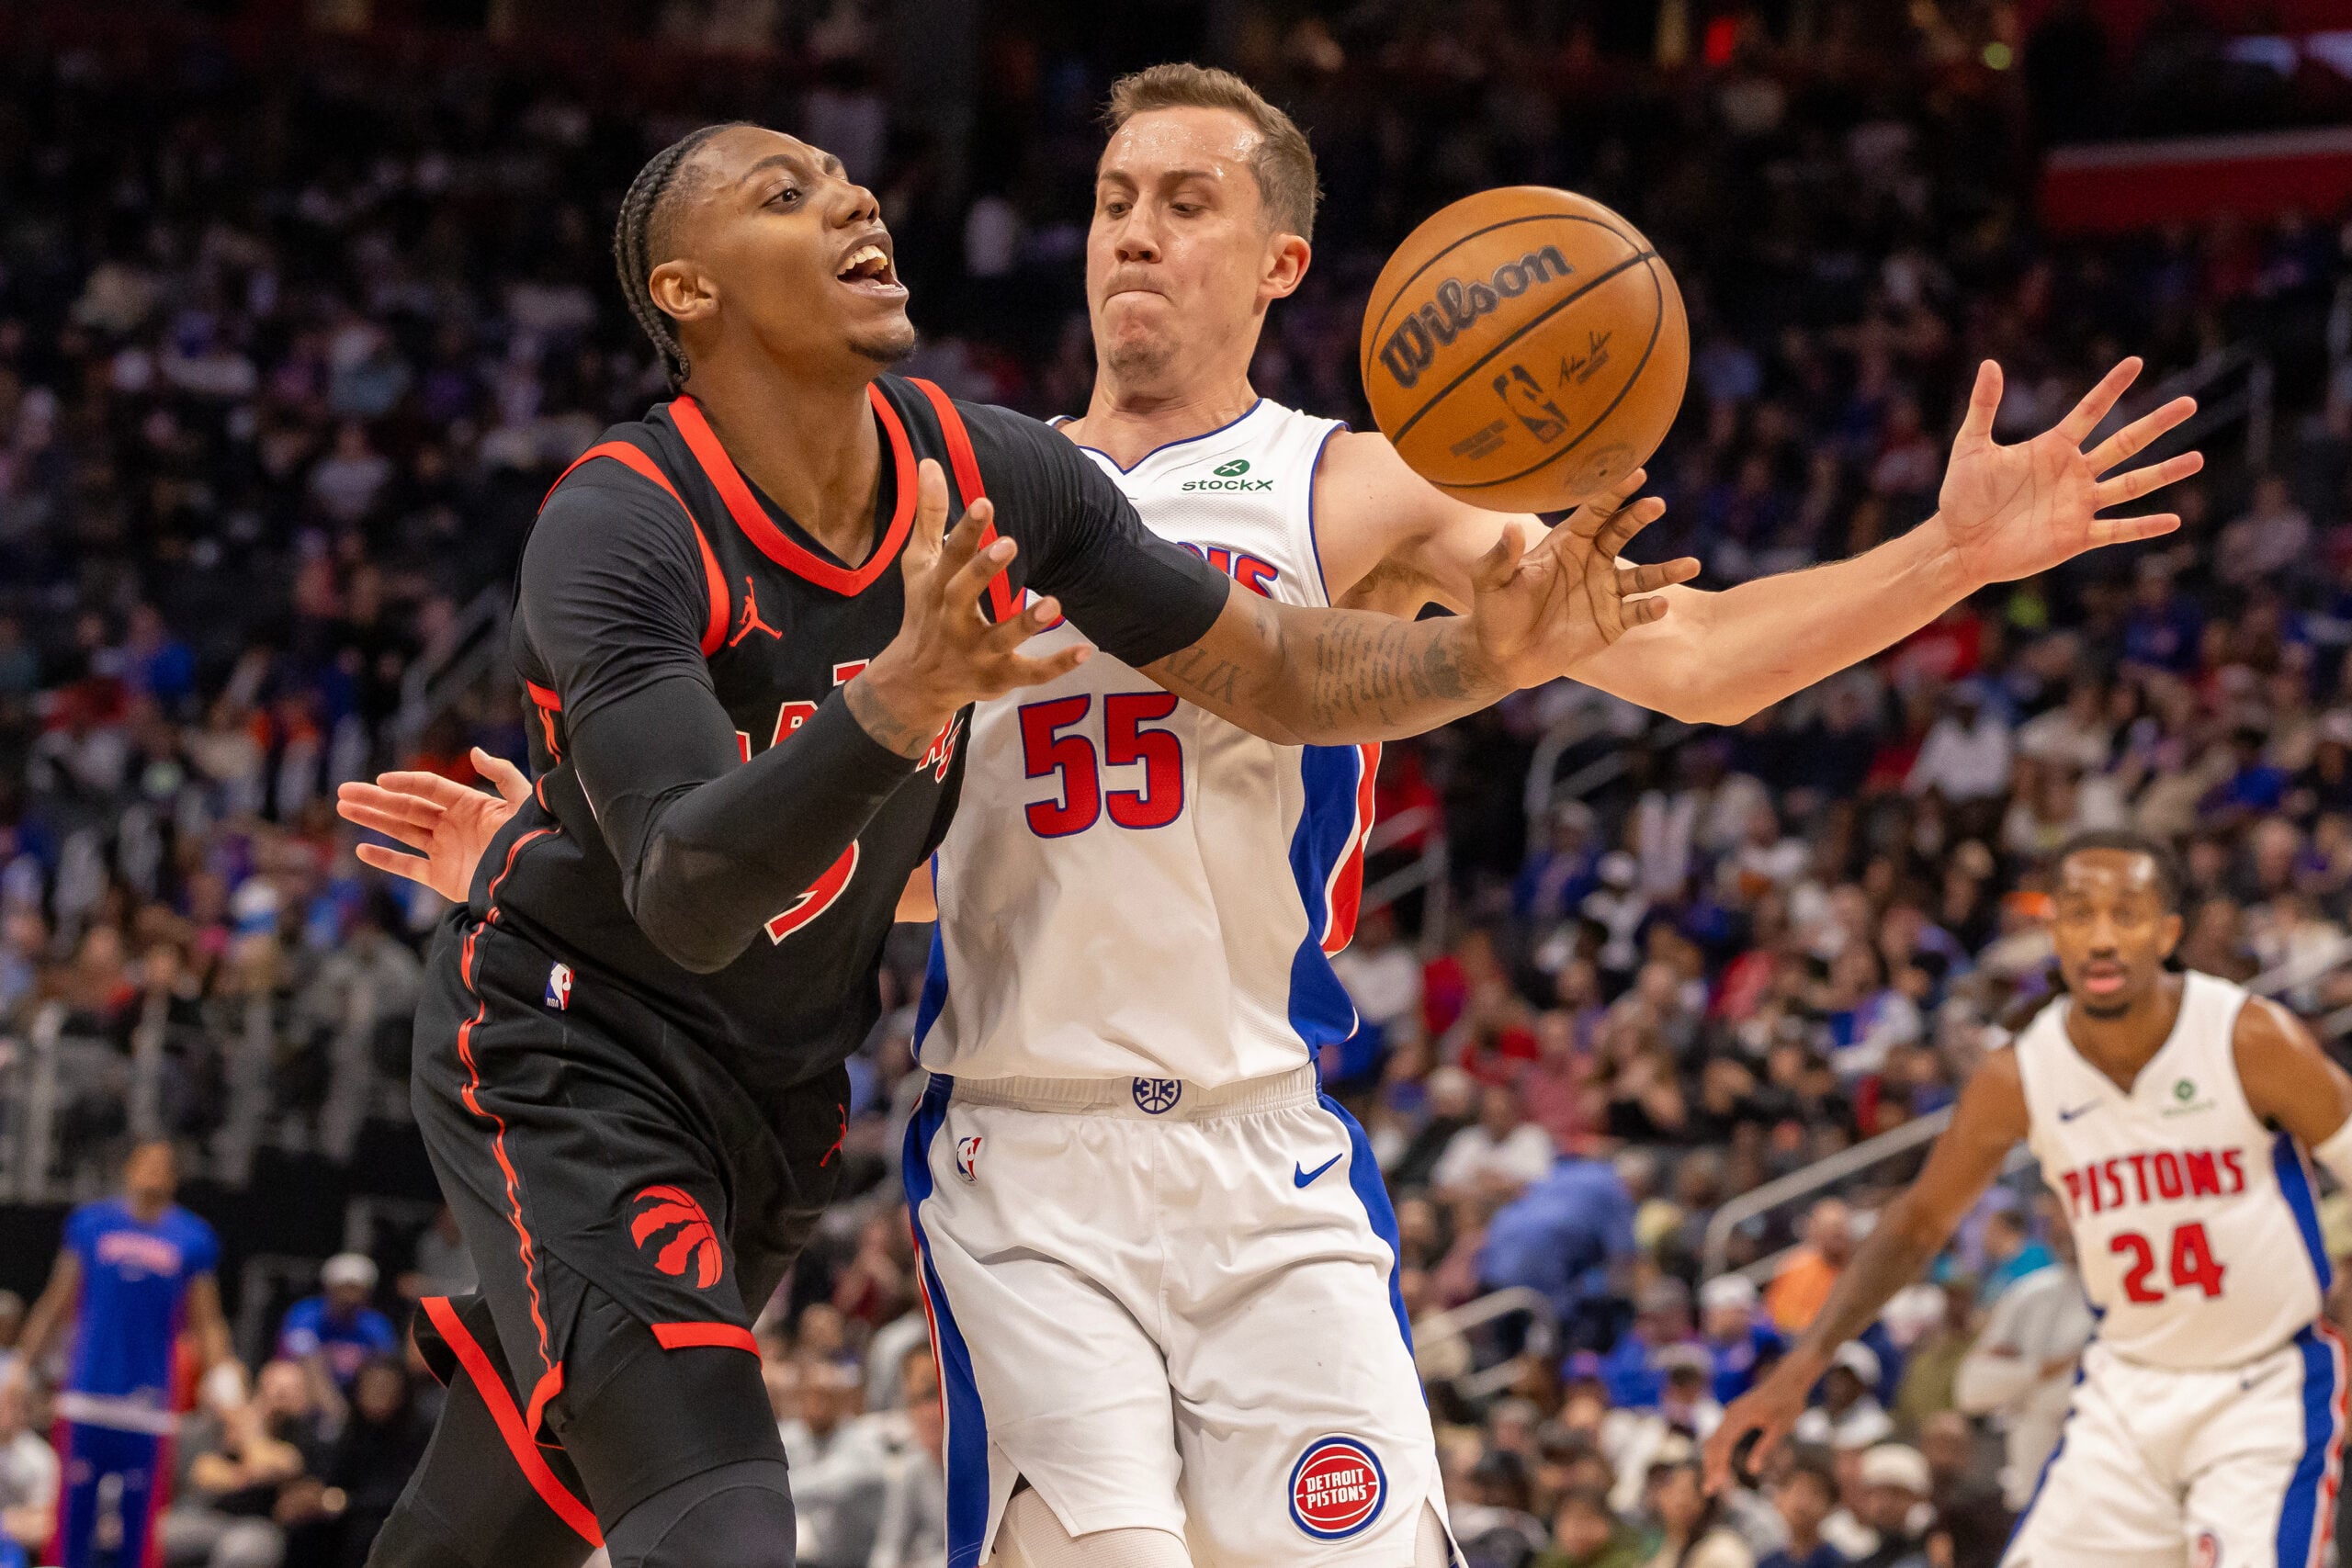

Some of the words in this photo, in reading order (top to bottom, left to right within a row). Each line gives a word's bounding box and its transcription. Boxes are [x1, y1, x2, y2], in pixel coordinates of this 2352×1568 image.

[1379, 244, 1575, 389] Wilson
[1017, 692, 1185, 839] 55
[546, 997, 560, 1009] NBA
[2062, 1148, 2245, 1220] PISTONS
[2109, 1222, 2226, 1303] 24
[1305, 1467, 1364, 1493] DETROIT
[1305, 1484, 1367, 1509] PISTONS
